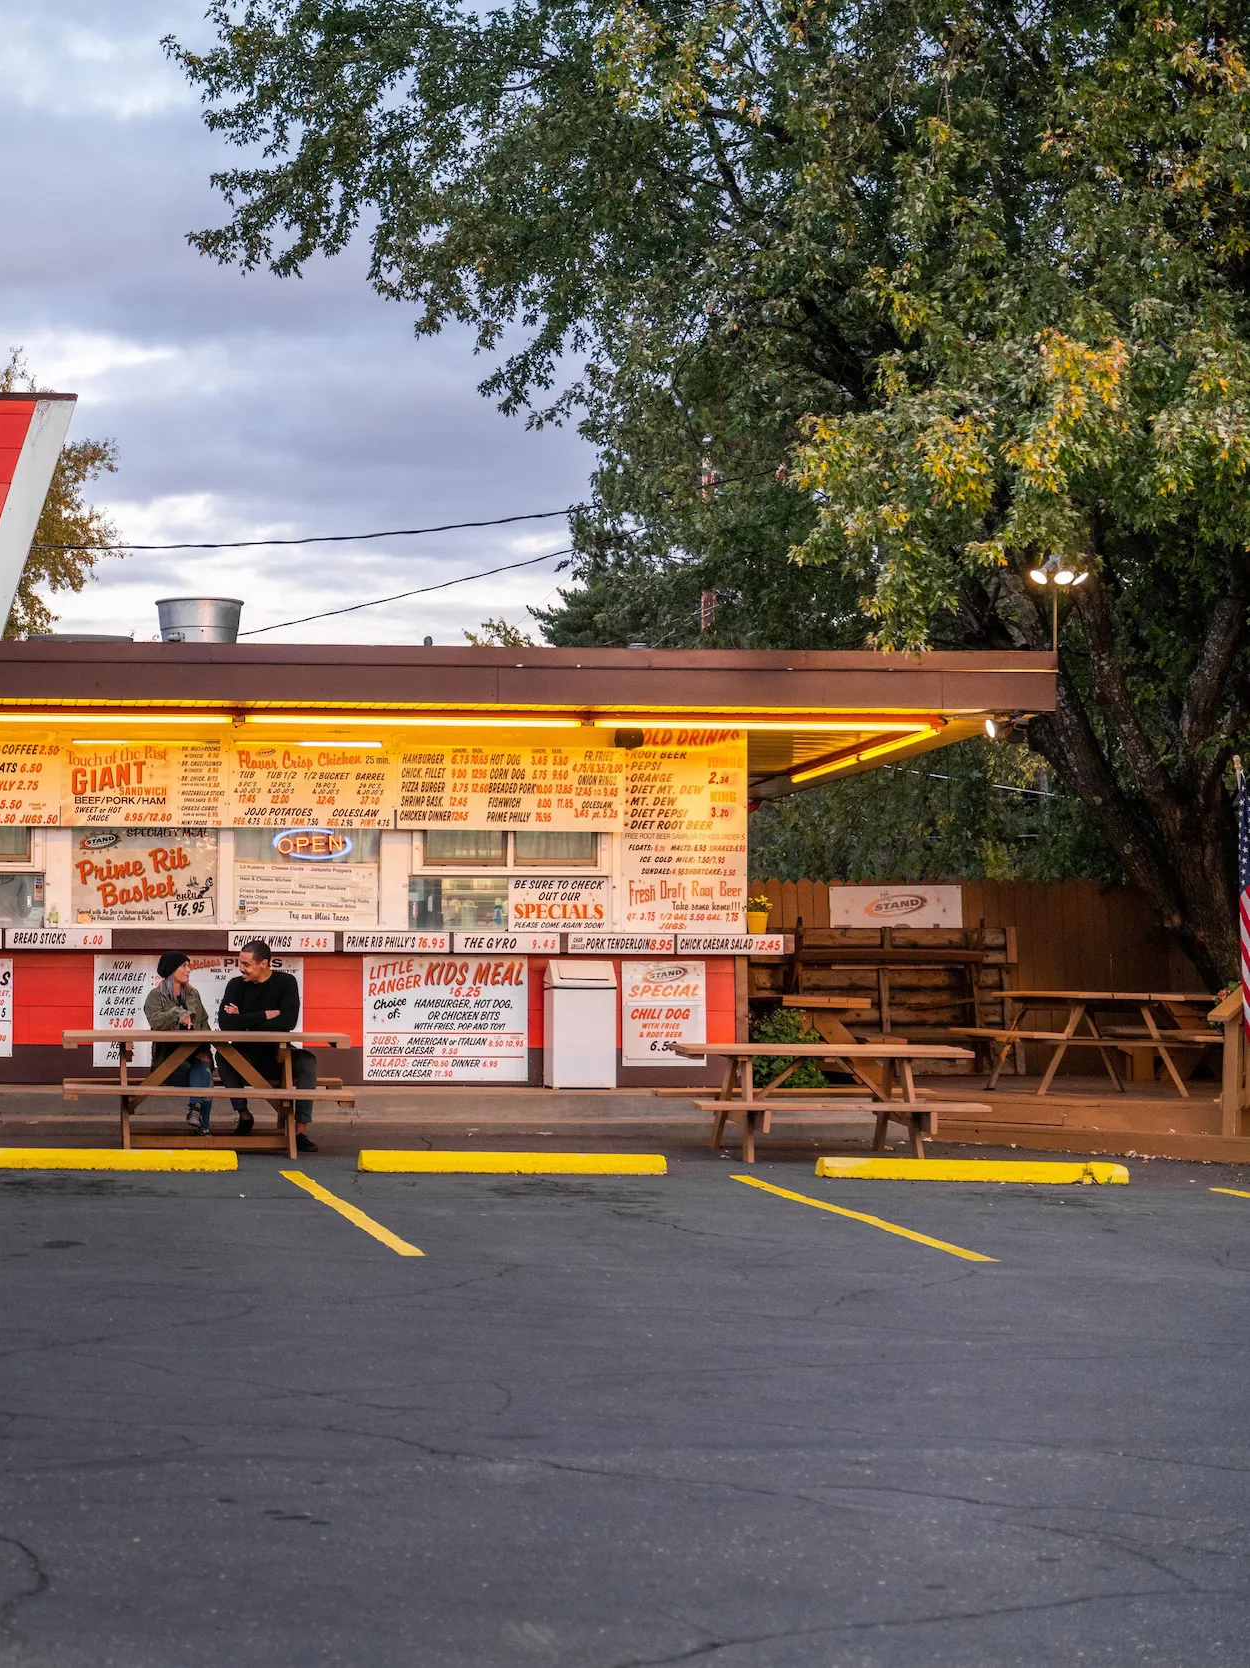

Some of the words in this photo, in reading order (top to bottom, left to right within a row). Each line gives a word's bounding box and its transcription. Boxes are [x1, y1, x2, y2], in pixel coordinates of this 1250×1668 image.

[237, 750, 278, 770] Flavor
[282, 751, 313, 770] Crisp
[318, 752, 363, 766] Chicken
[366, 756, 374, 764] 25
[20, 763, 42, 773] 6.50
[631, 762, 662, 770] PEPSI
[72, 761, 146, 795] GIANT
[630, 774, 673, 782] ORANGE
[119, 787, 167, 796] SANDWICH
[400, 811, 427, 820] CHICKEN
[428, 811, 452, 821] DINNER
[278, 834, 344, 854] OPEN
[75, 859, 145, 885] Prime
[149, 846, 191, 874] Rib
[514, 880, 526, 889] BE
[529, 880, 553, 889] SURE
[557, 880, 568, 889] TO
[570, 881, 604, 890] CHECK
[96, 875, 178, 907] Basket
[538, 892, 558, 901] OUT
[561, 892, 580, 901] OUR
[174, 902, 205, 917] $16.95
[672, 901, 689, 910] Take
[874, 899, 919, 911] STAND
[514, 904, 604, 919] SPECIALS
[13, 933, 38, 944] BREAD
[40, 934, 66, 944] STICKS
[83, 935, 103, 945] 6.00
[269, 937, 292, 947] WINGS
[299, 937, 328, 947] 15.45
[346, 937, 369, 947] PRIME
[371, 937, 383, 947] RIB
[384, 937, 416, 948] PHILLY'S
[418, 938, 445, 948] 16.95
[464, 938, 484, 948] THE
[486, 938, 517, 949] GYRO
[532, 940, 556, 949] 9.45
[585, 938, 605, 949] PORK
[607, 938, 651, 950] TENDERLOIN
[649, 939, 672, 951] 8.95
[755, 940, 780, 950] 12.45
[370, 959, 415, 980] LITTLE
[424, 962, 469, 986] KIDS
[472, 962, 524, 986] MEAL
[649, 970, 682, 979] STAND
[98, 973, 147, 982] AVAILABLE!
[368, 974, 421, 996] RANGER
[450, 987, 481, 998] $6.25
[628, 984, 699, 998] SPECIAL
[374, 997, 407, 1010] Choice
[414, 999, 472, 1009] HAMBURGER,
[474, 999, 490, 1008] HOT
[492, 1000, 513, 1009] DOG,
[388, 1009, 401, 1020] of:
[428, 1012, 440, 1020] OR
[441, 1012, 479, 1020] CHICKEN
[481, 1012, 500, 1020] BITS
[631, 1008, 661, 1020] CHILI
[665, 1009, 690, 1019] DOG
[109, 1018, 134, 1028] $3.00
